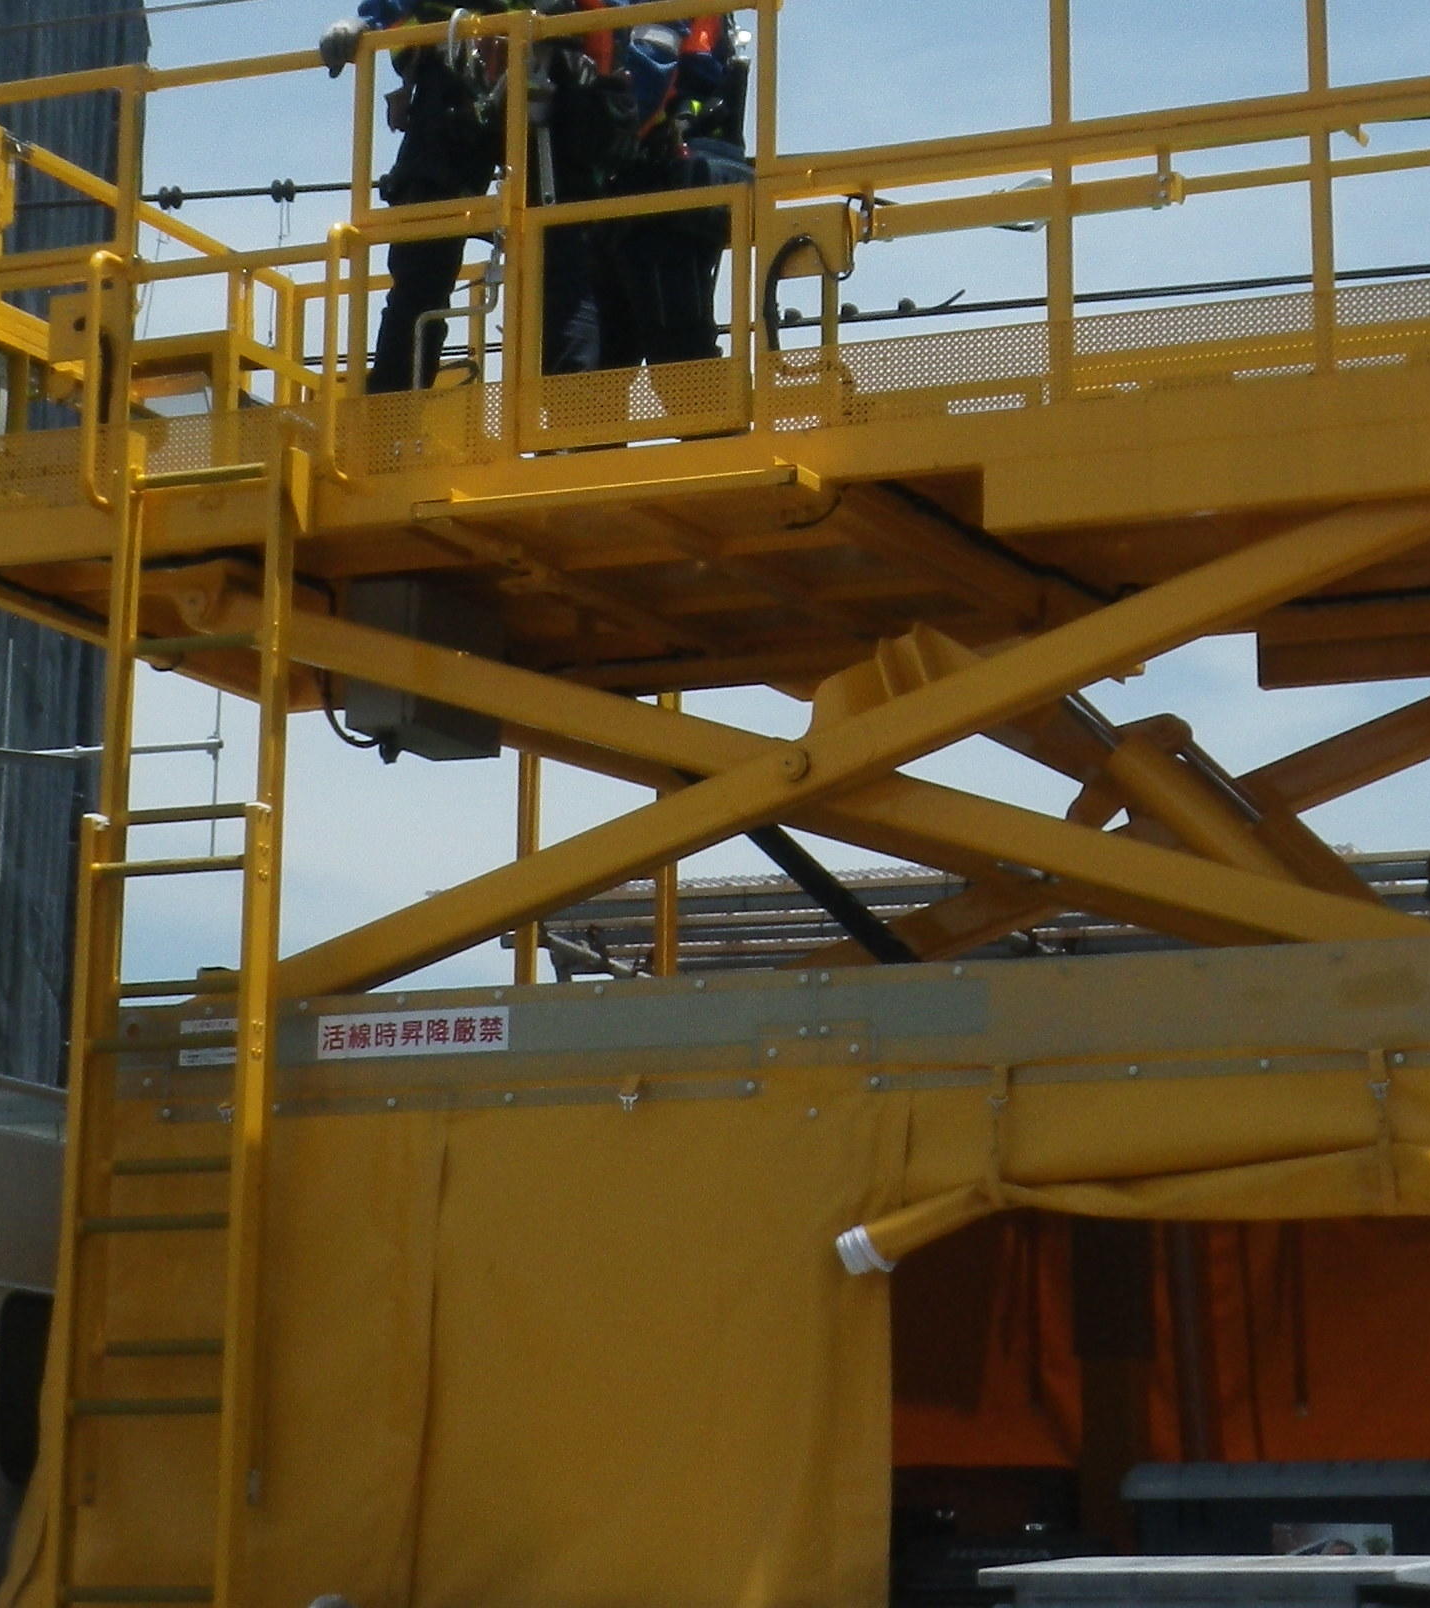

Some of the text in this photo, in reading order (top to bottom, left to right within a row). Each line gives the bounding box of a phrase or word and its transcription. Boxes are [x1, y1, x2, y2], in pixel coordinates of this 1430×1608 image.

[322, 1015, 503, 1051] 活線時昇降厳禁
